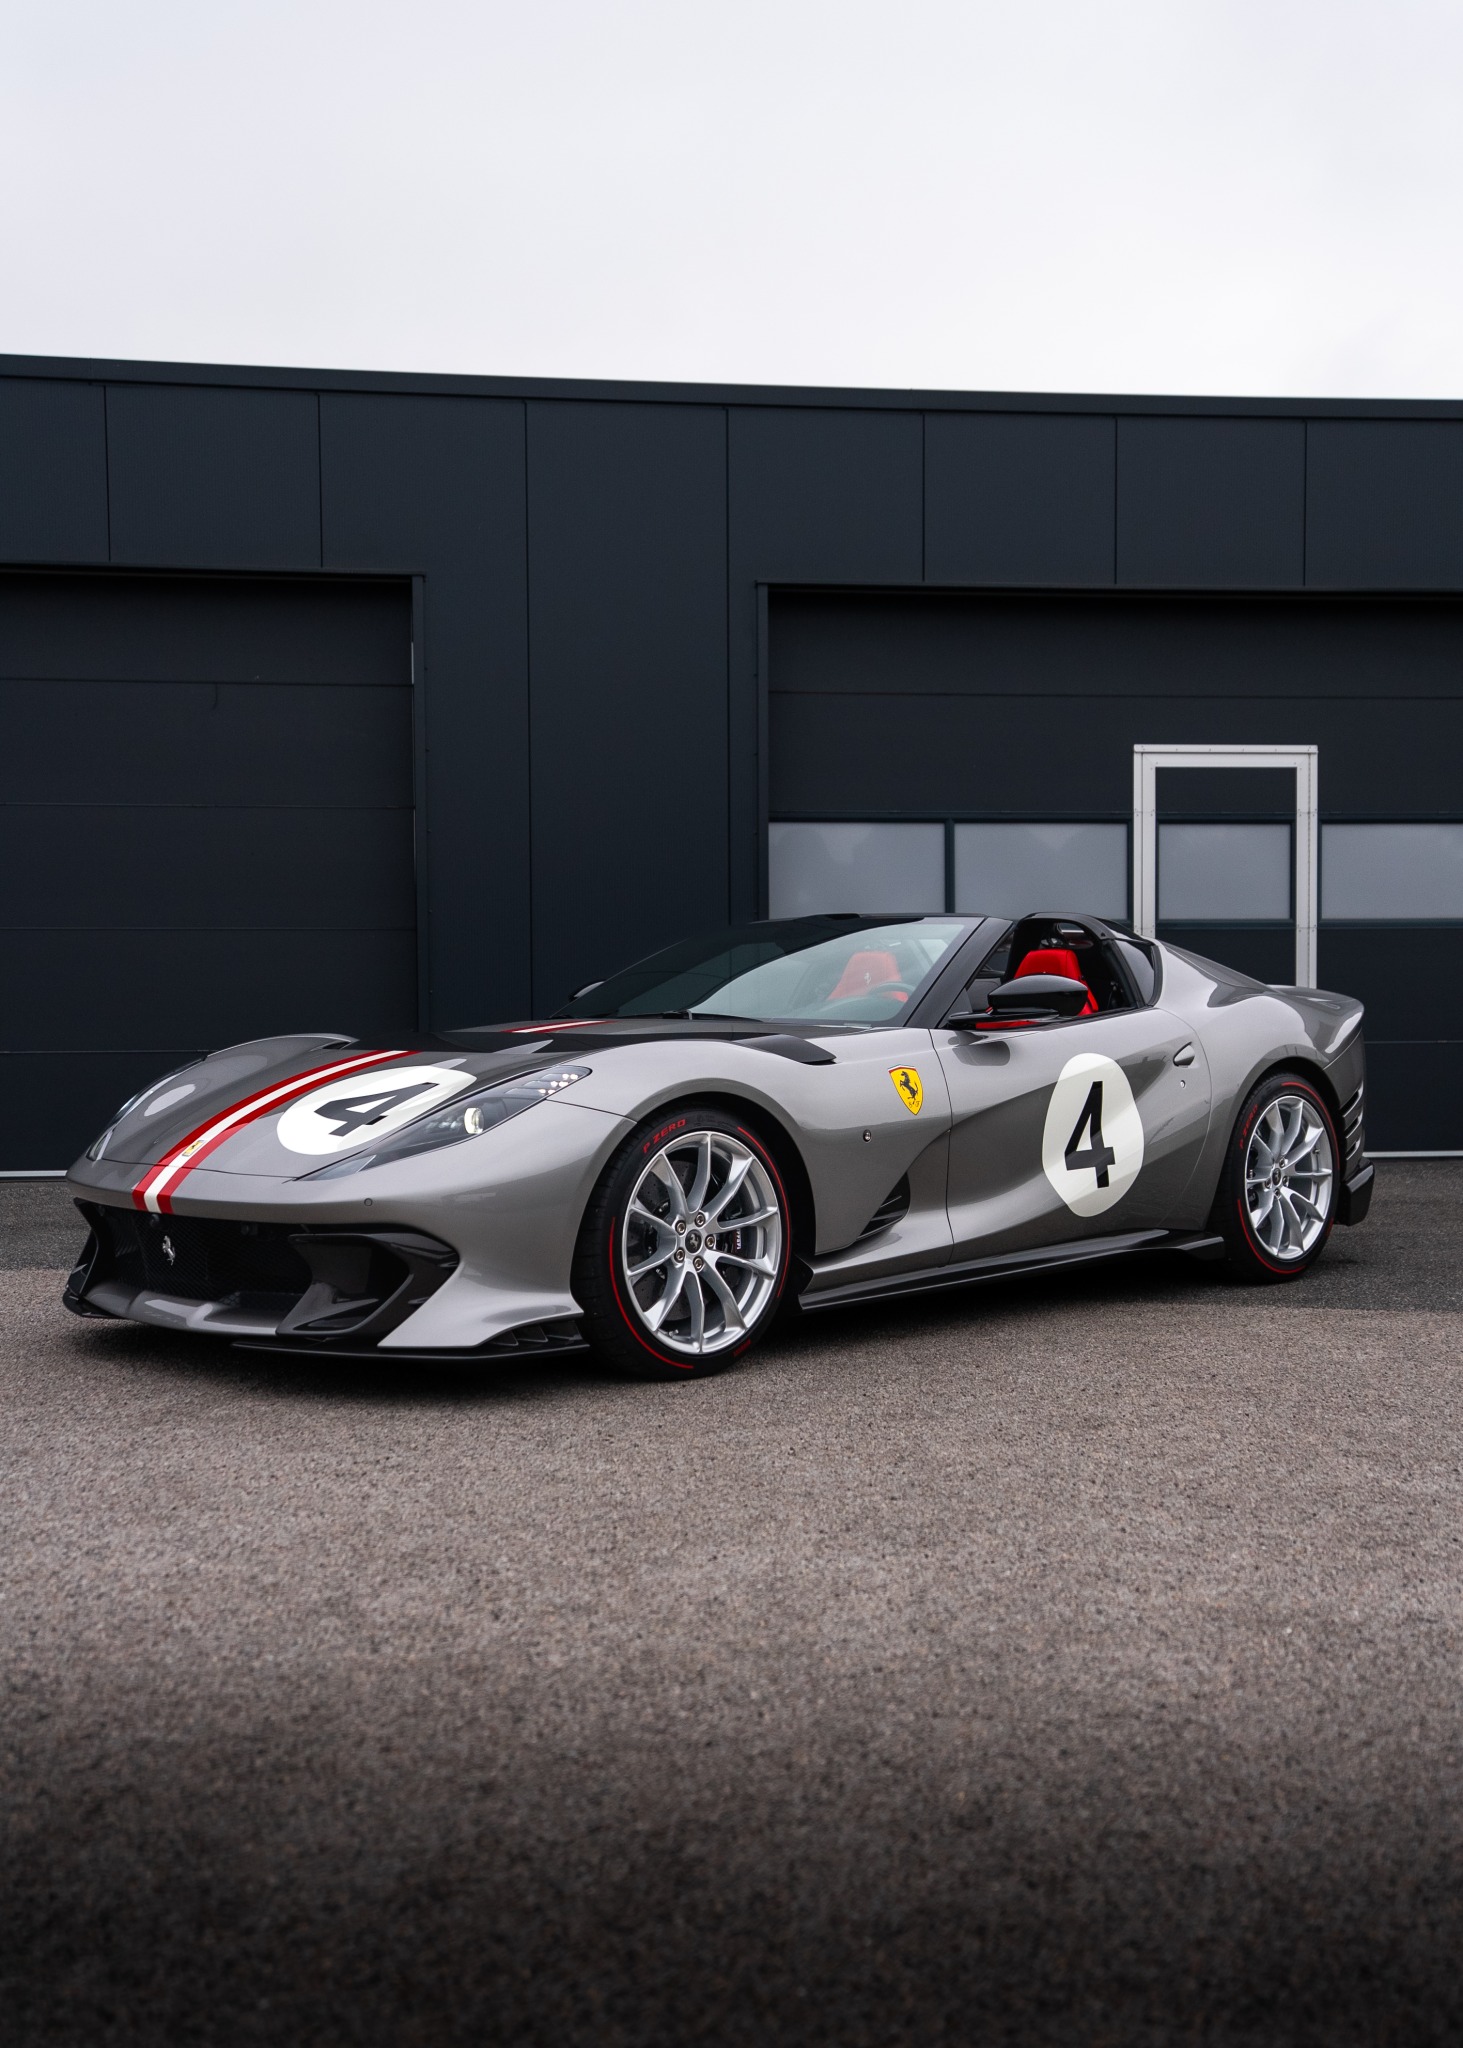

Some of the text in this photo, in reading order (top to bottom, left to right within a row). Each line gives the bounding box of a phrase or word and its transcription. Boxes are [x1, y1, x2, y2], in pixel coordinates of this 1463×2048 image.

[313, 1082, 440, 1137] 4
[642, 1118, 687, 1154] P ZERO
[1064, 1080, 1116, 1189] 4
